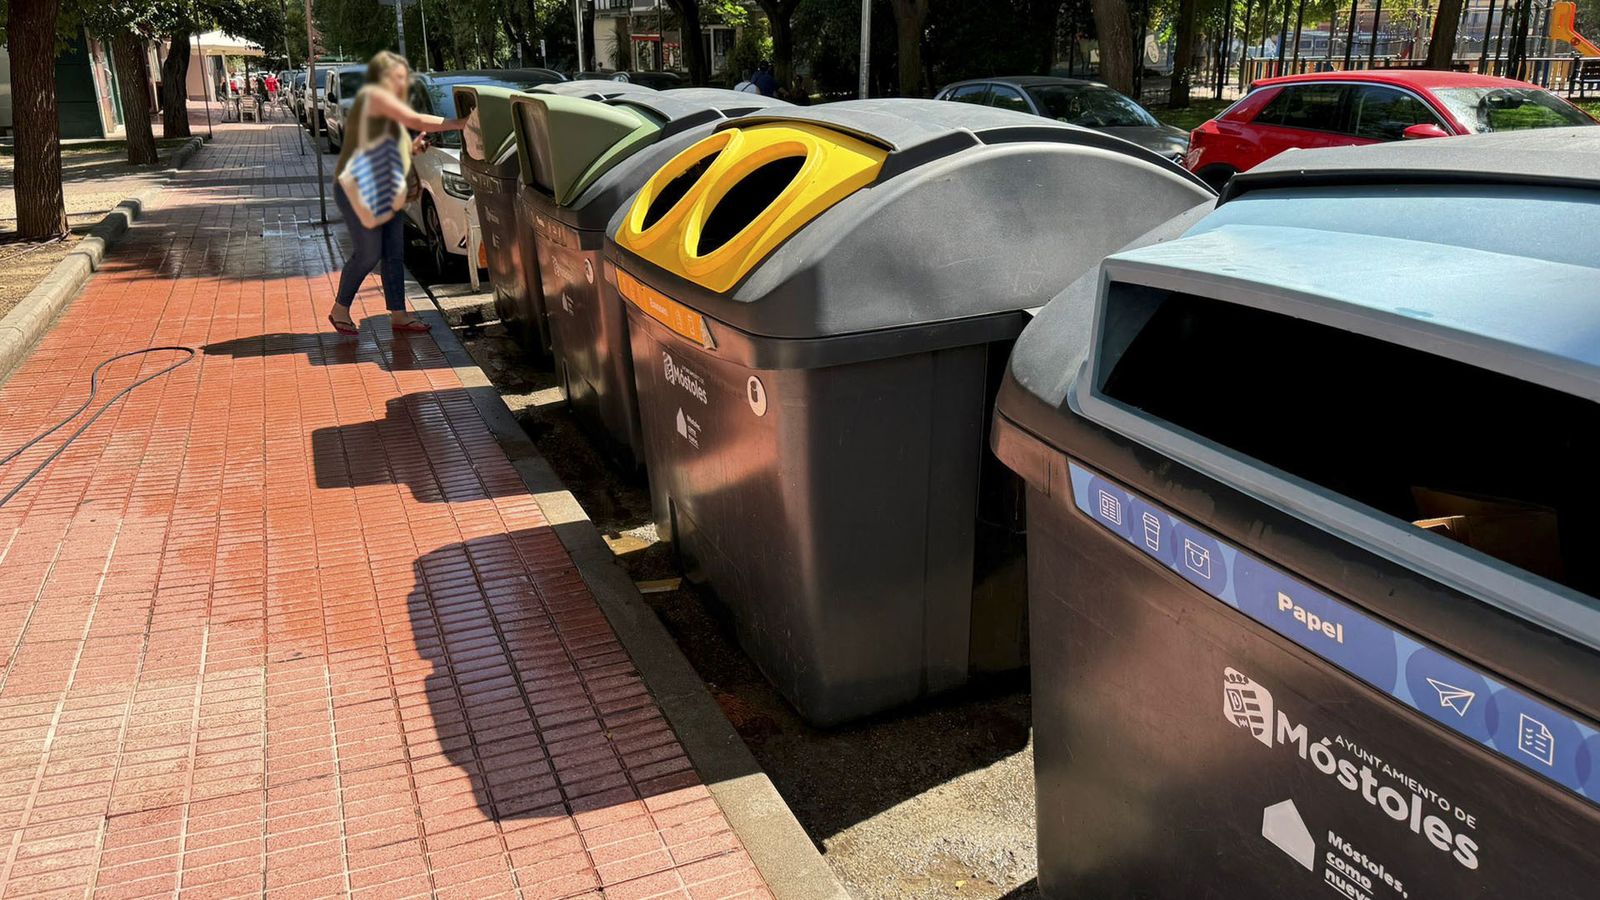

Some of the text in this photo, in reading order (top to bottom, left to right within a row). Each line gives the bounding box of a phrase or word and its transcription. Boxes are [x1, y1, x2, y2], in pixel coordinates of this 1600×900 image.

[1278, 591, 1343, 643] Papel
[1276, 709, 1479, 870] Móstoles
[1335, 735, 1477, 830] AYUNTAMIENTO DE
[1325, 868, 1372, 900] nuev
[1326, 852, 1372, 889] como
[1328, 830, 1408, 899] Móstoles,
